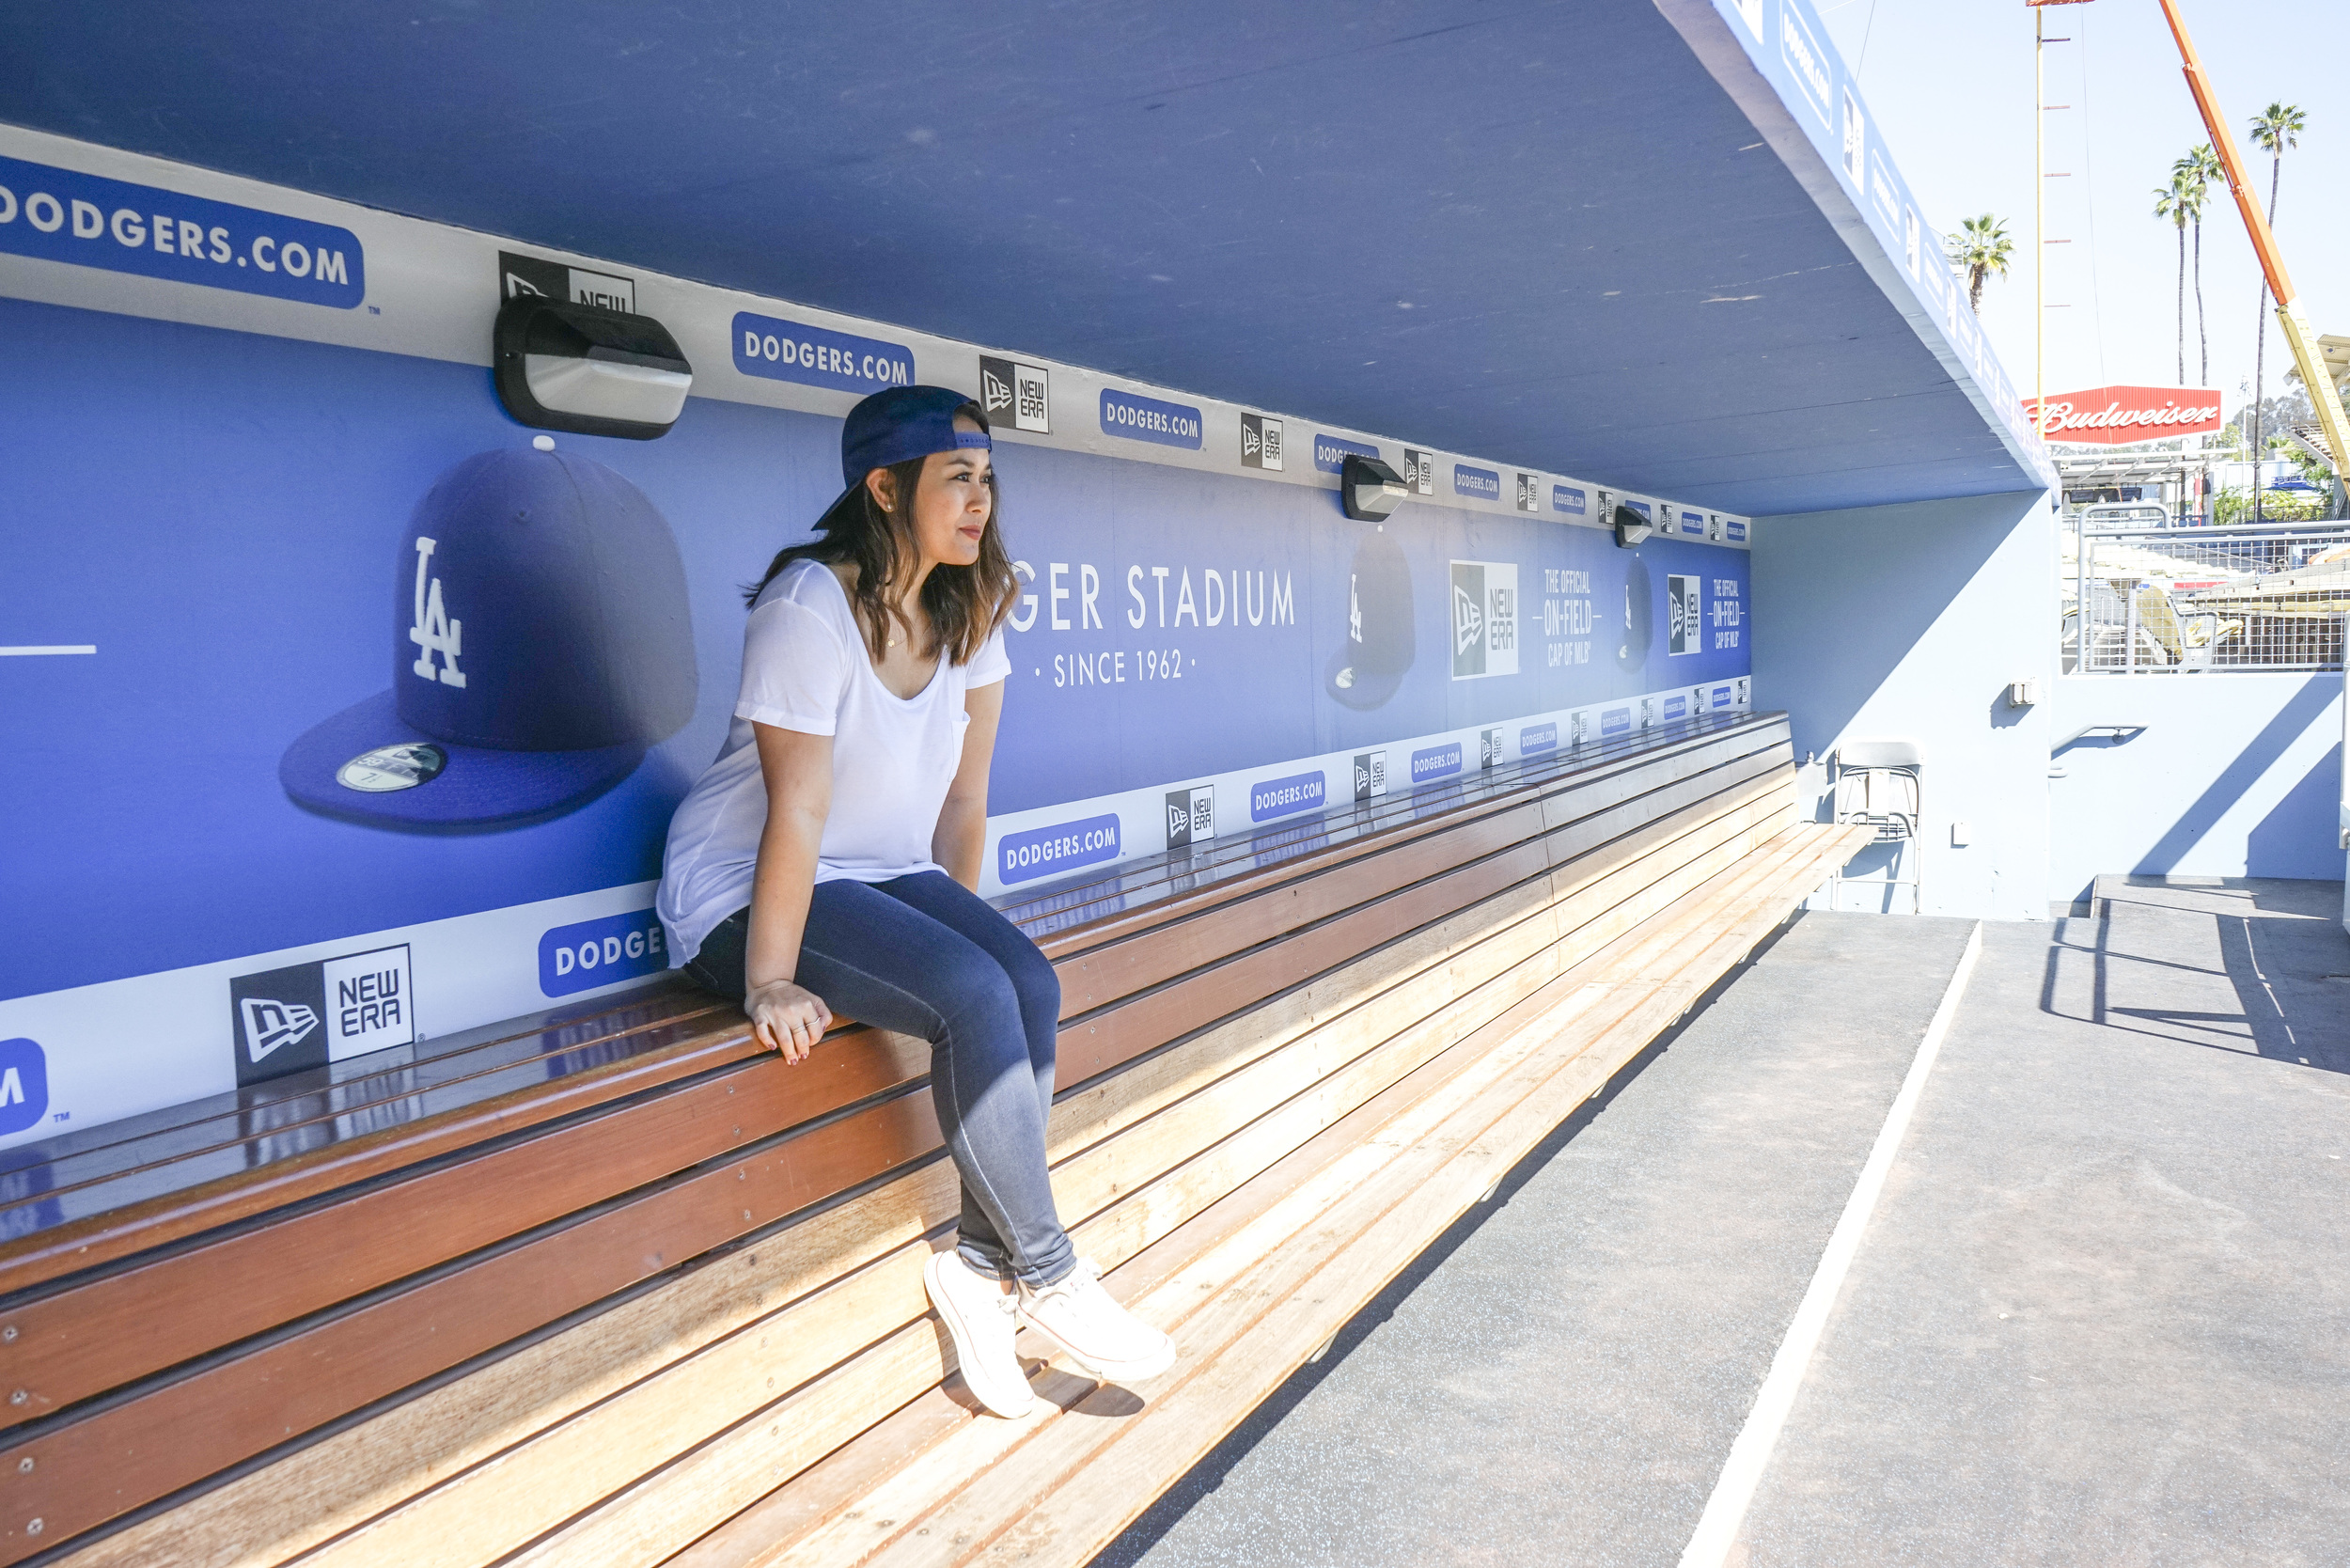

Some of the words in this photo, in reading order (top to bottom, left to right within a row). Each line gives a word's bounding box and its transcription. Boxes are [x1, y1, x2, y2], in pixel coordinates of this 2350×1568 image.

[745, 331, 907, 385] DODGERS.COM
[1020, 379, 1044, 400] NEW
[1021, 399, 1044, 419] ERA
[1107, 402, 1198, 438] DODGERS.COM
[2023, 401, 2218, 434] Budweiser
[1264, 429, 1280, 446] NEW
[1265, 445, 1280, 461] ERA
[1457, 473, 1498, 493] DODGERS.COM
[1554, 493, 1585, 509] DODGERS.COM
[1545, 569, 1559, 593] THE
[1561, 570, 1590, 594] OFFICIAL
[1127, 565, 1295, 629] STADIUM
[1490, 588, 1513, 619] NEW
[410, 537, 466, 689] LA
[1544, 599, 1591, 636] ON-FIELD
[1490, 620, 1514, 651] ERA
[1054, 651, 1125, 688] SINCE
[1136, 649, 1182, 681] 1962
[1548, 643, 1562, 667] CAP
[1565, 642, 1573, 666] OF
[1522, 729, 1557, 747] DODGERS.COM
[1414, 751, 1461, 774] DODGERS.COM
[1256, 781, 1323, 811] DODGERS.COM
[1372, 774, 1385, 788] ERA
[1194, 797, 1211, 816] NEW
[1194, 813, 1212, 831] ERA
[1007, 827, 1116, 870] DODGERS.COM
[556, 926, 668, 976] DODGE
[339, 968, 399, 1008] NEW
[341, 998, 400, 1038] ERA
